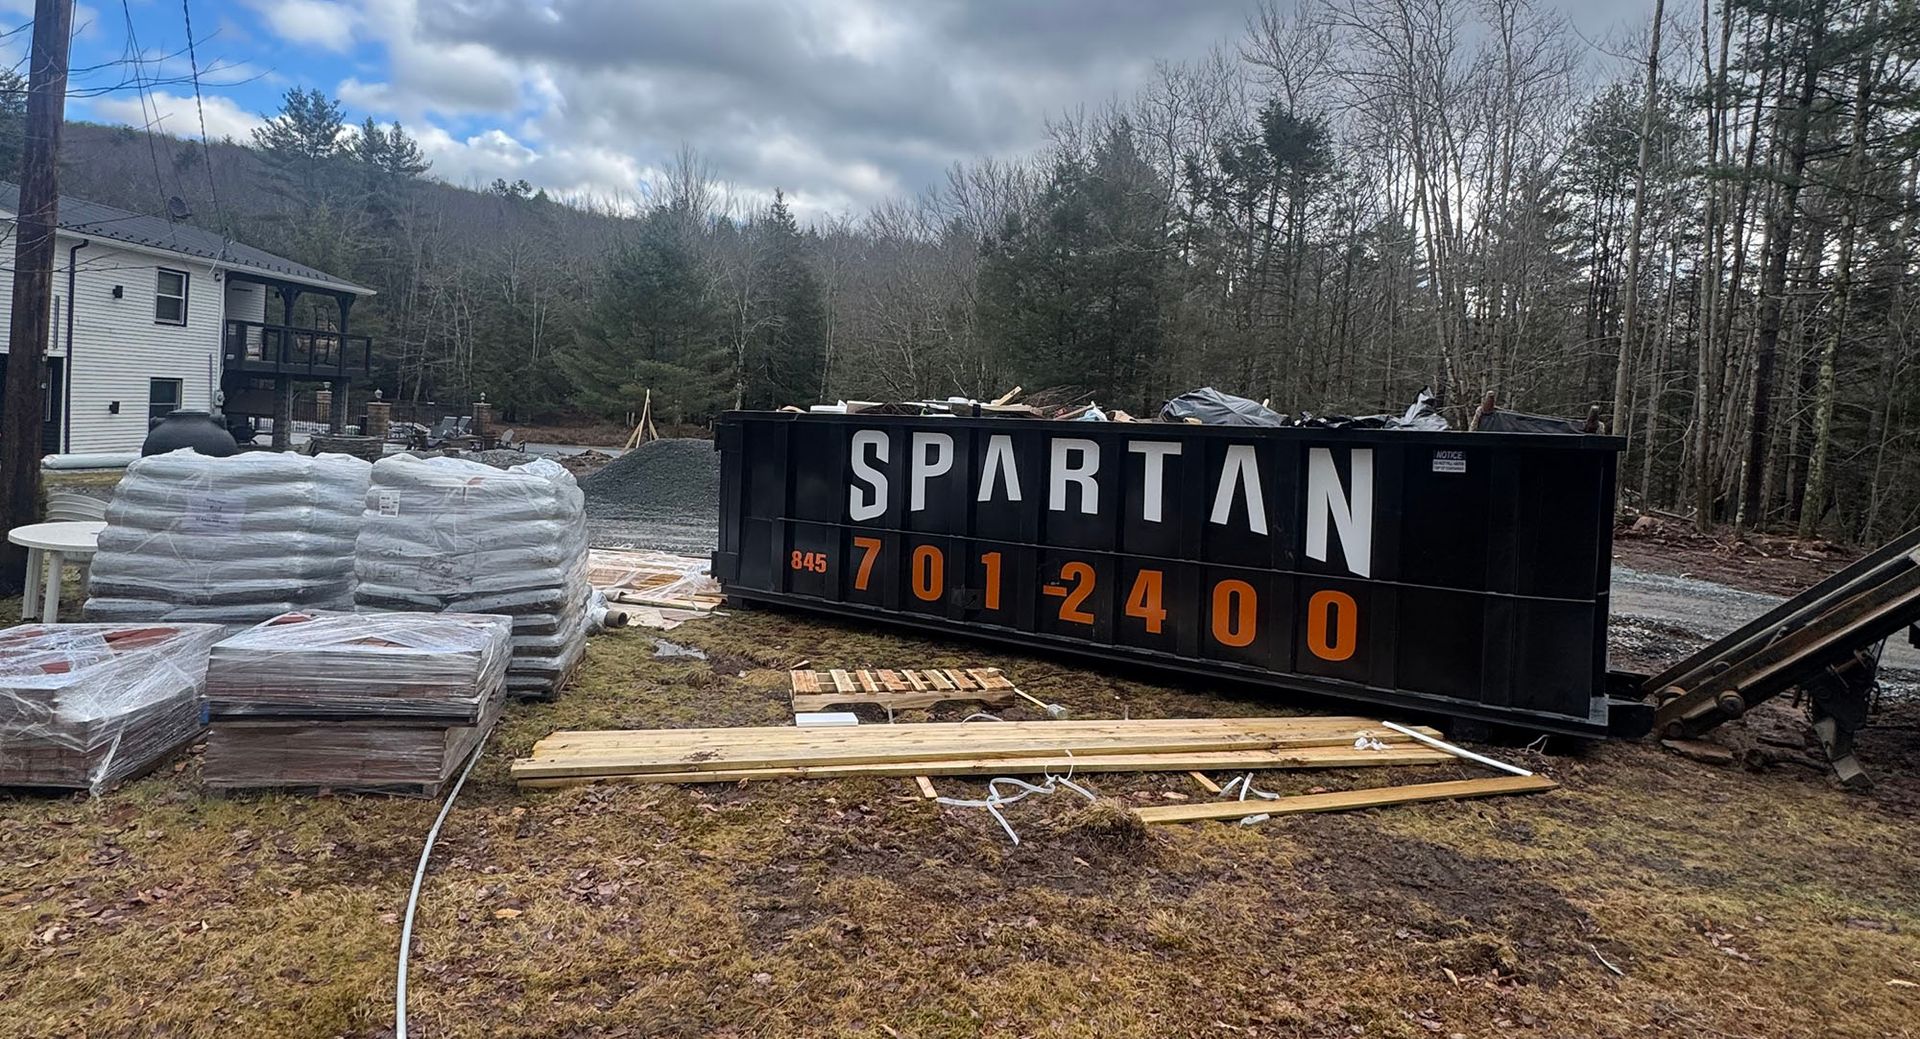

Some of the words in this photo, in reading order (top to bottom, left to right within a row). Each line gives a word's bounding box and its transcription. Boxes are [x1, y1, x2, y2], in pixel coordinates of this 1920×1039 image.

[1436, 450, 1463, 459] NOTICE
[849, 430, 1373, 579] SPARTAN
[790, 550, 827, 574] 845
